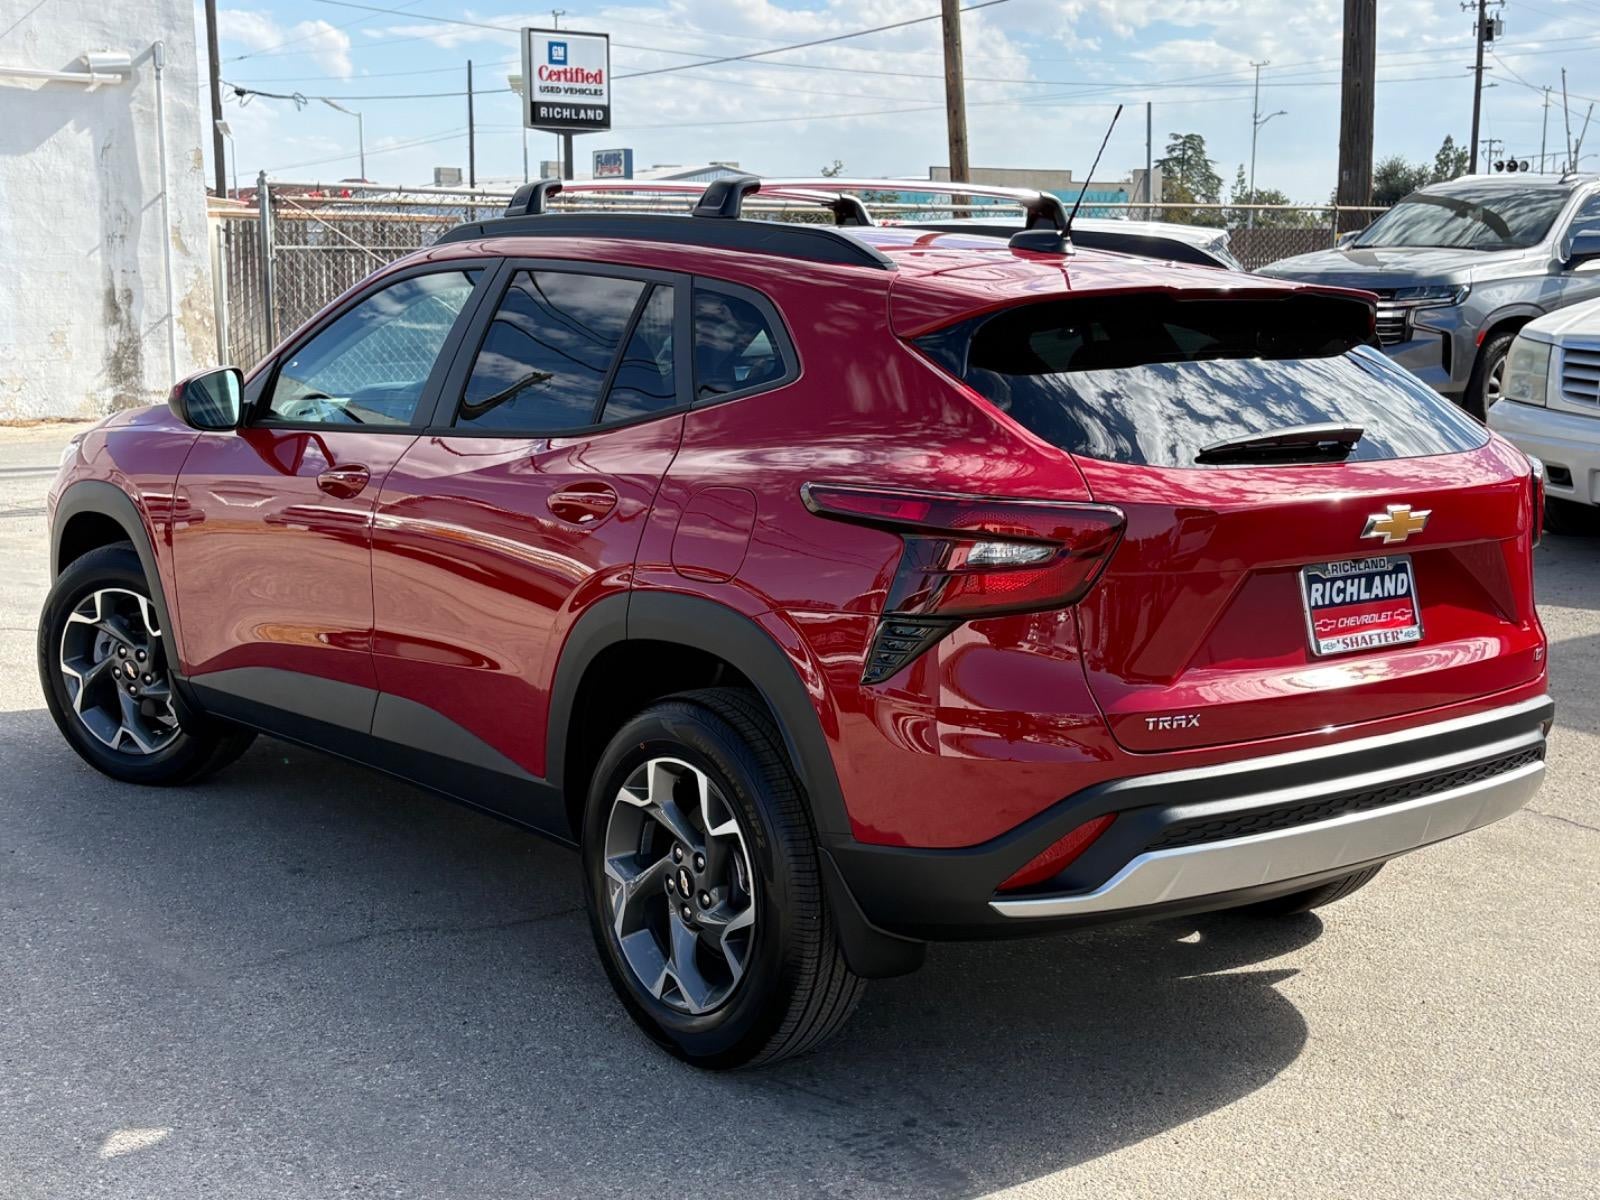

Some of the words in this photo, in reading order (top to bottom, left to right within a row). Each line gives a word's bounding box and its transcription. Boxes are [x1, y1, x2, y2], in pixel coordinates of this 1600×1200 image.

[538, 65, 603, 84] Certified
[539, 85, 562, 94] USED
[563, 87, 603, 97] VEHICLES
[540, 107, 604, 121] RICHLAND
[1331, 558, 1386, 573] RICHLAND
[1310, 573, 1408, 606] RICHLAND
[1337, 612, 1393, 628] CHEVROLET
[1145, 714, 1201, 731] TRAX
